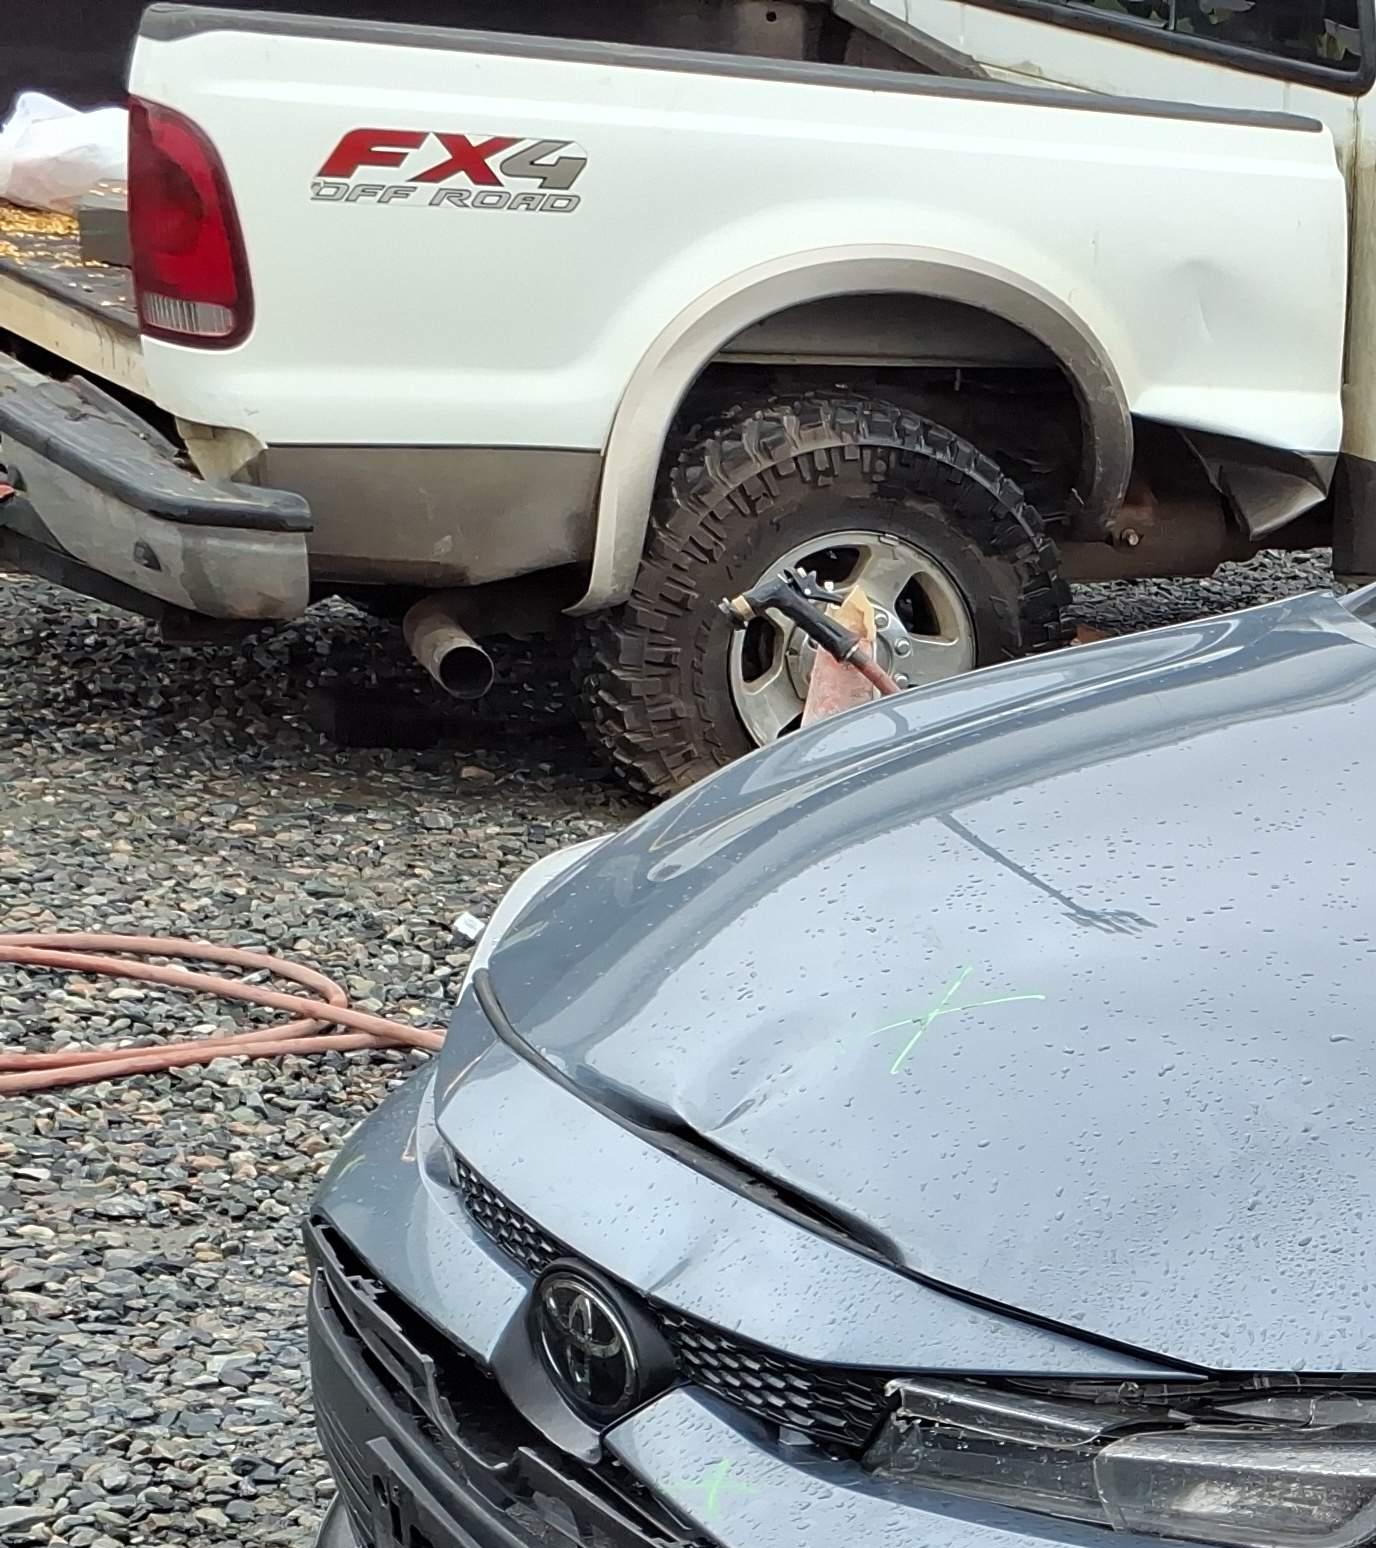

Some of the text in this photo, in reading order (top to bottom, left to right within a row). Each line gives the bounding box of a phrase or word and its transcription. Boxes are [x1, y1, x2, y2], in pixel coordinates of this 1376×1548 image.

[317, 128, 588, 190] FX4
[310, 181, 581, 213] OFF ROAD
